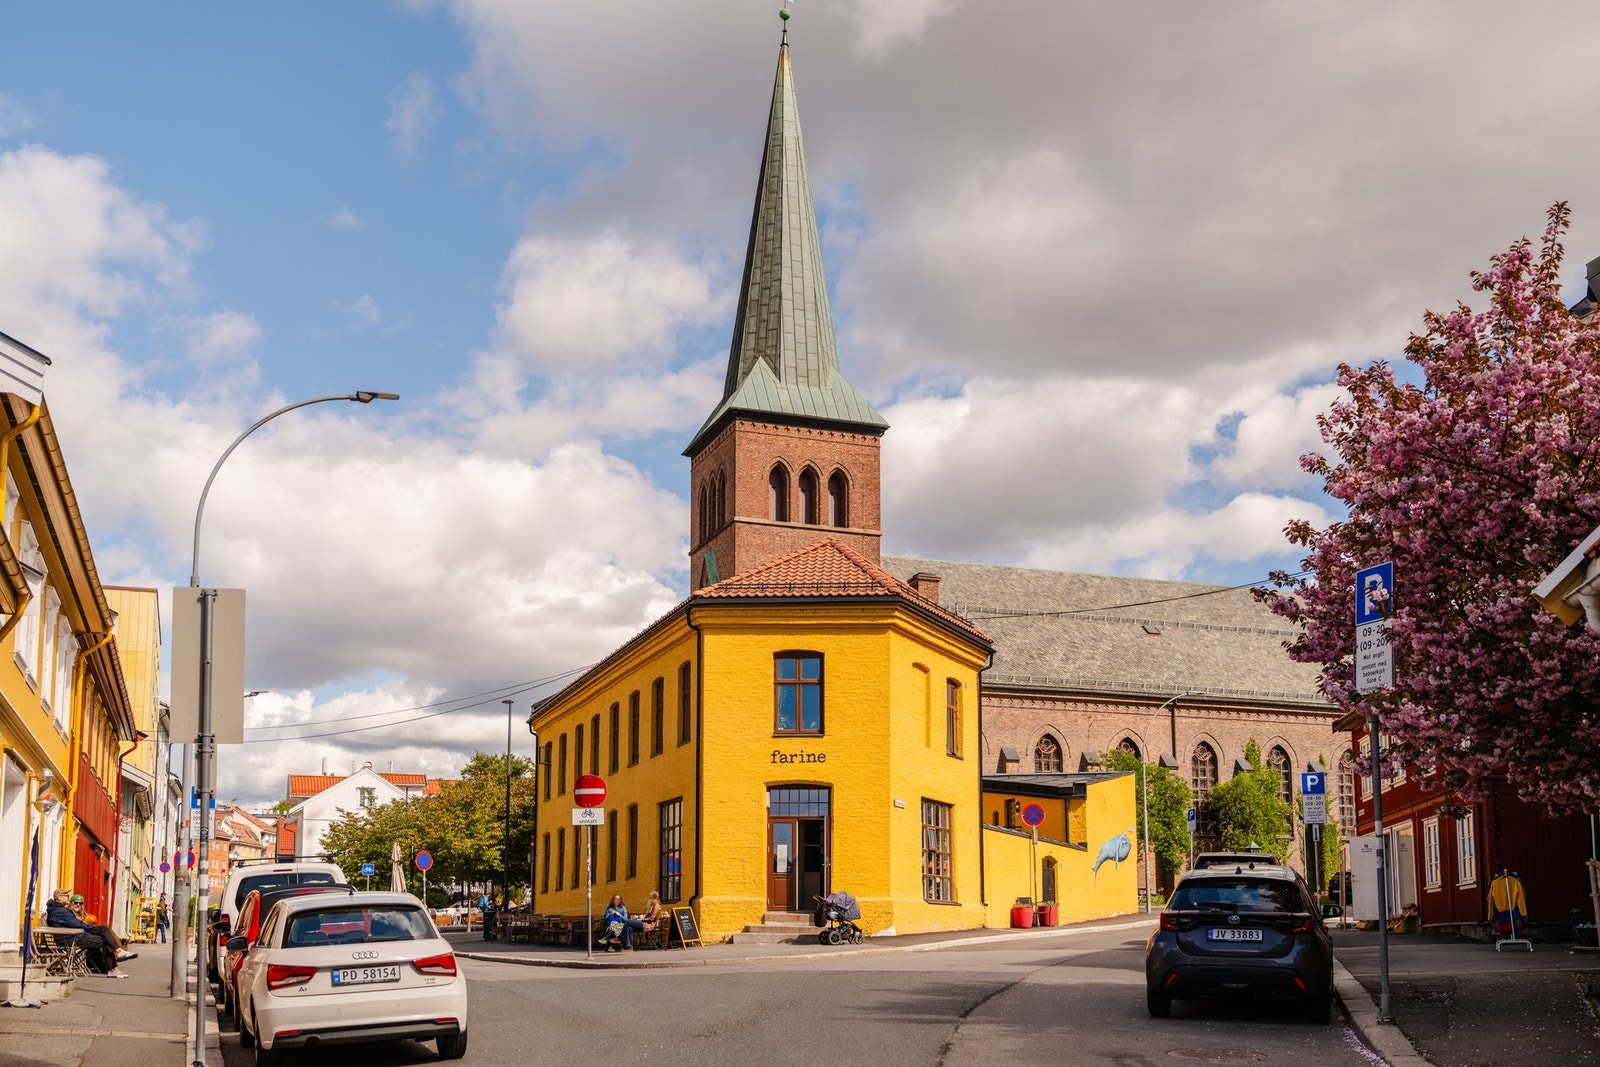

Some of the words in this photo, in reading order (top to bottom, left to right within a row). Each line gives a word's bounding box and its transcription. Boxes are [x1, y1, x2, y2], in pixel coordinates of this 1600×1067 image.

[770, 749, 827, 764] farine
[1307, 775, 1319, 792] P
[1189, 811, 1194, 819] P
[1215, 930, 1227, 939] JV
[1230, 930, 1260, 940] 33883
[342, 969, 358, 981] PD
[362, 967, 397, 980] 58154
